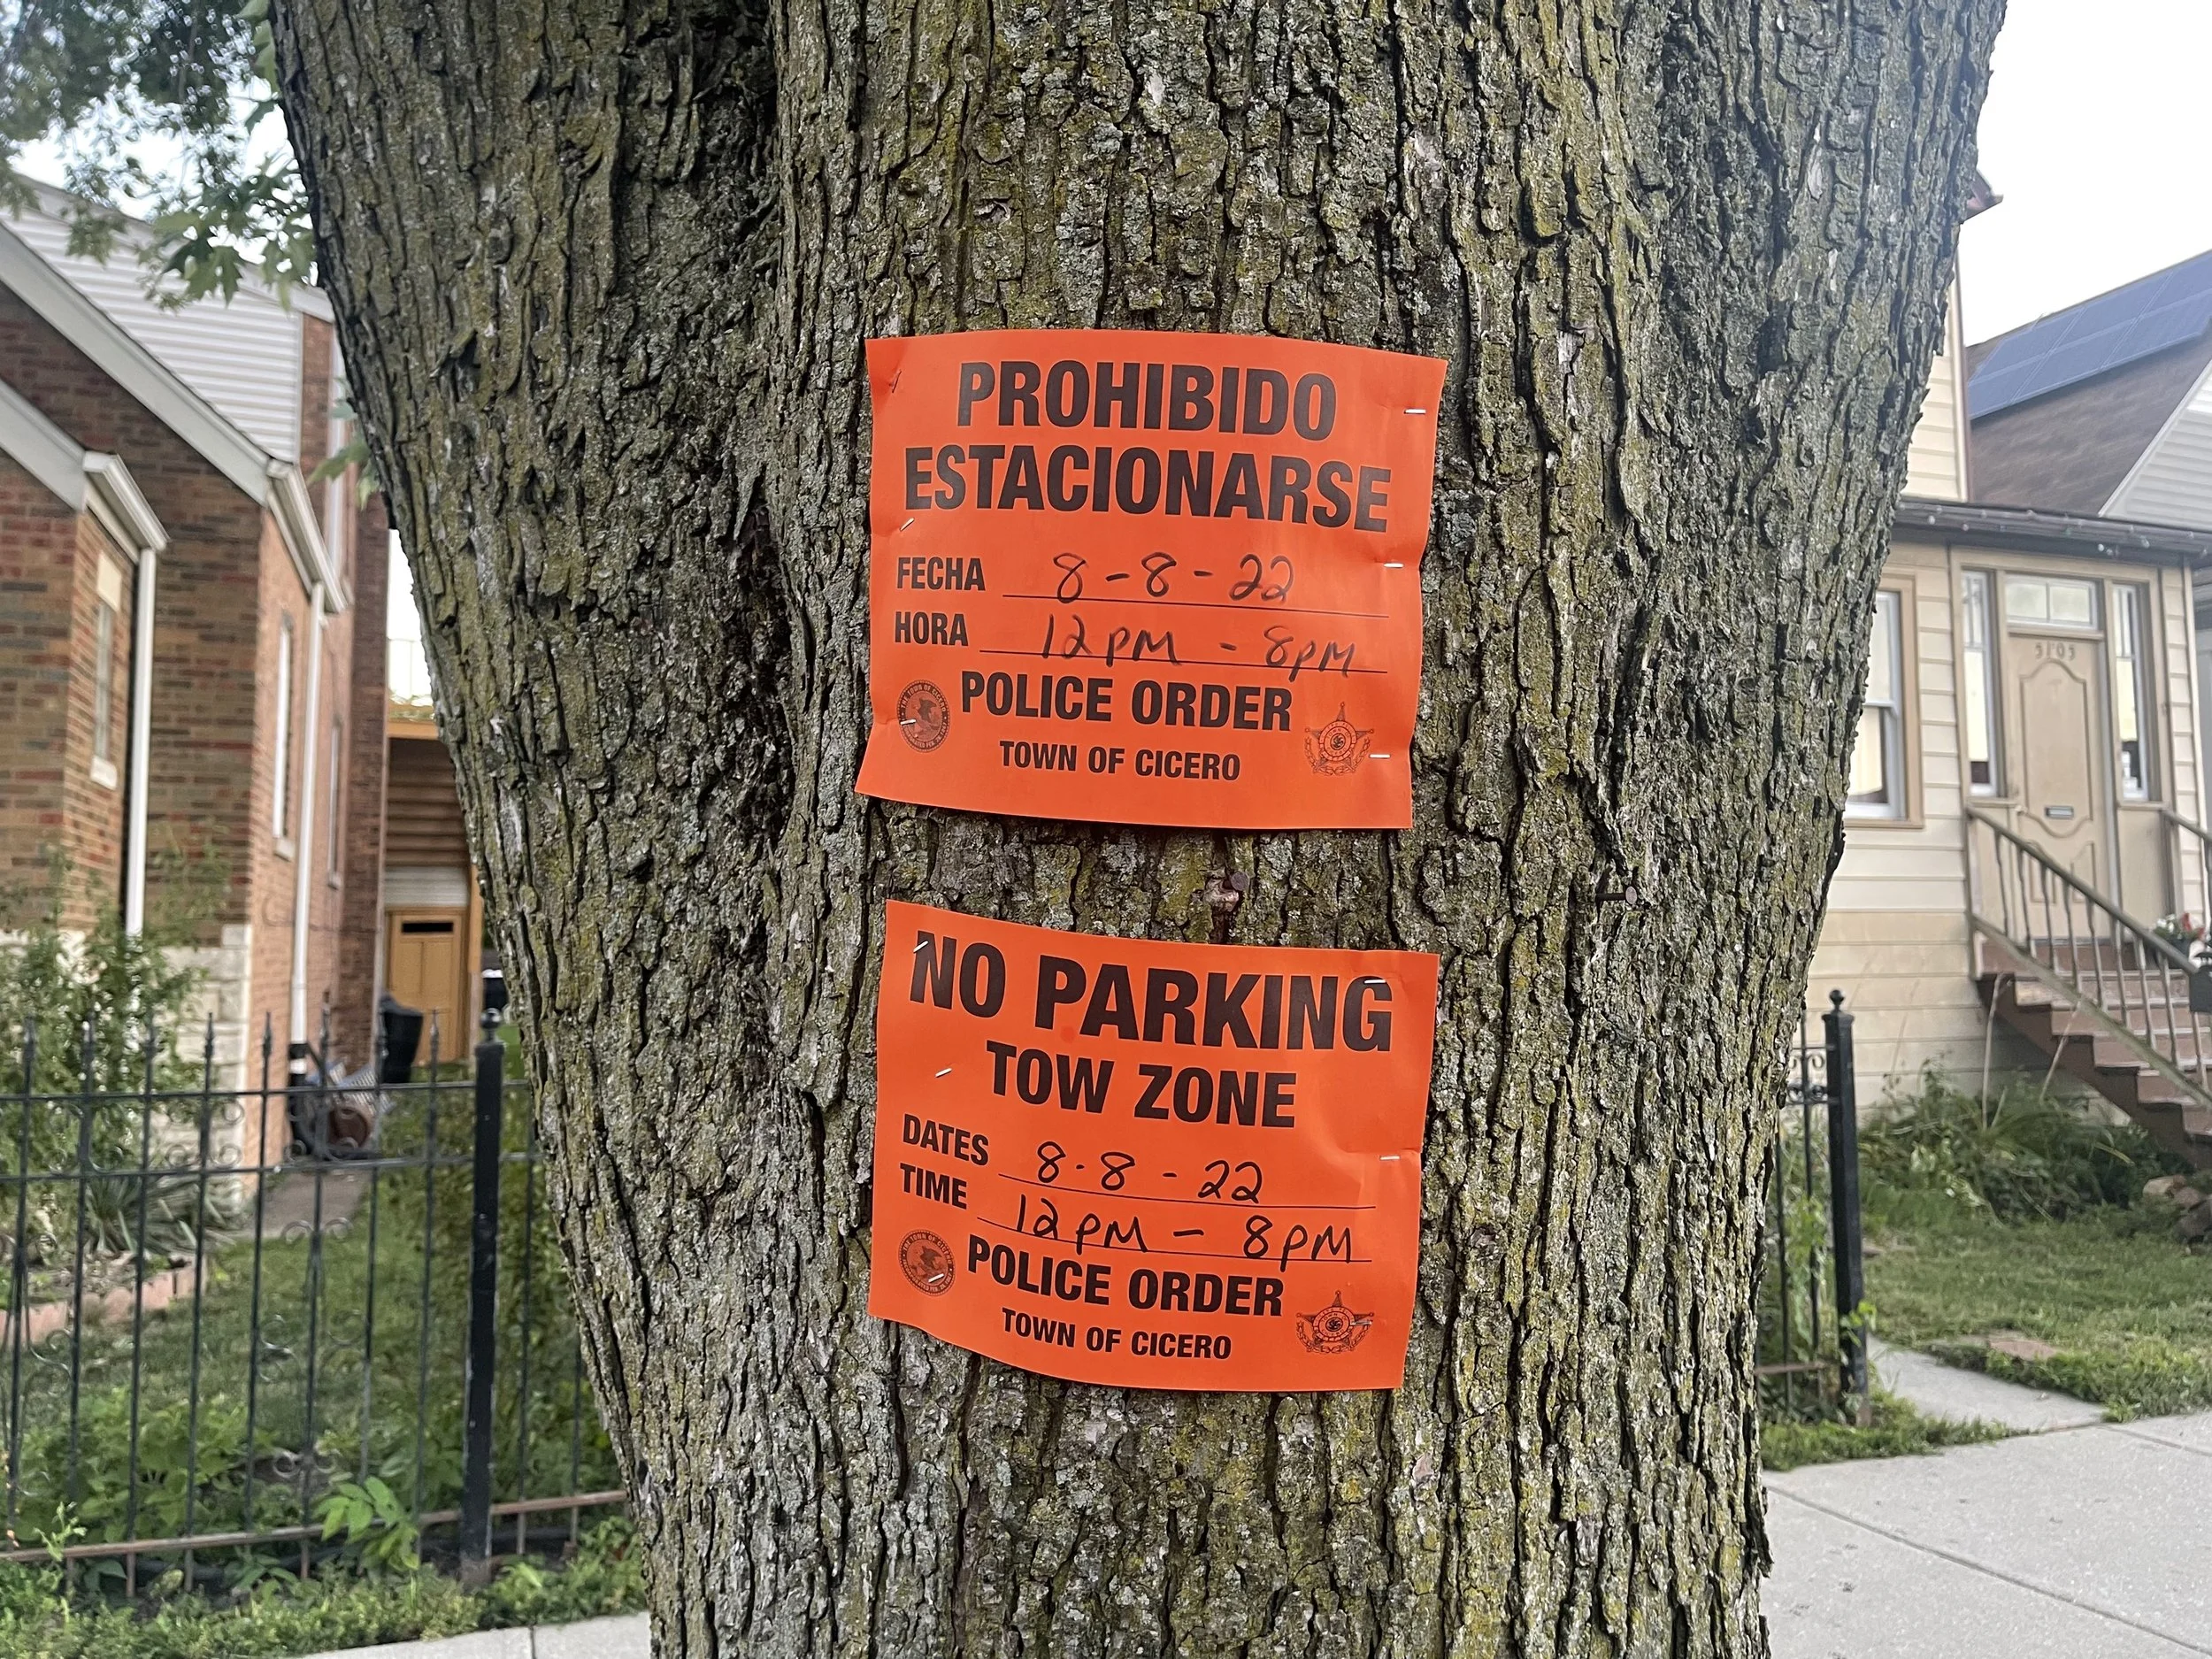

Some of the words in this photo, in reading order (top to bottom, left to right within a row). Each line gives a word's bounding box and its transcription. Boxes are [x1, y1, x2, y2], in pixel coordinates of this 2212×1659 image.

[957, 359, 1337, 442] PROHIBIDO
[904, 444, 1392, 533] ESTACIONARSE
[896, 557, 986, 592] FECHA
[895, 611, 969, 647] HORA
[961, 670, 1113, 723] POLICE
[1131, 684, 1293, 733] ORDER
[999, 740, 1078, 772] TOWN
[1087, 746, 1125, 775] OF
[1135, 749, 1240, 782] CICERO
[910, 930, 1006, 1019] NO
[1033, 955, 1393, 1052] PARKING
[986, 1040, 1115, 1115] TOW
[1133, 1064, 1297, 1129] ZONE
[901, 1113, 990, 1166] DATES
[900, 1164, 968, 1210] TIME
[968, 1234, 1110, 1304] POLICE
[1128, 1268, 1284, 1317] ORDER
[1002, 1307, 1076, 1346] TOWN
[1086, 1326, 1122, 1354] OF
[1131, 1331, 1232, 1360] CICERO
